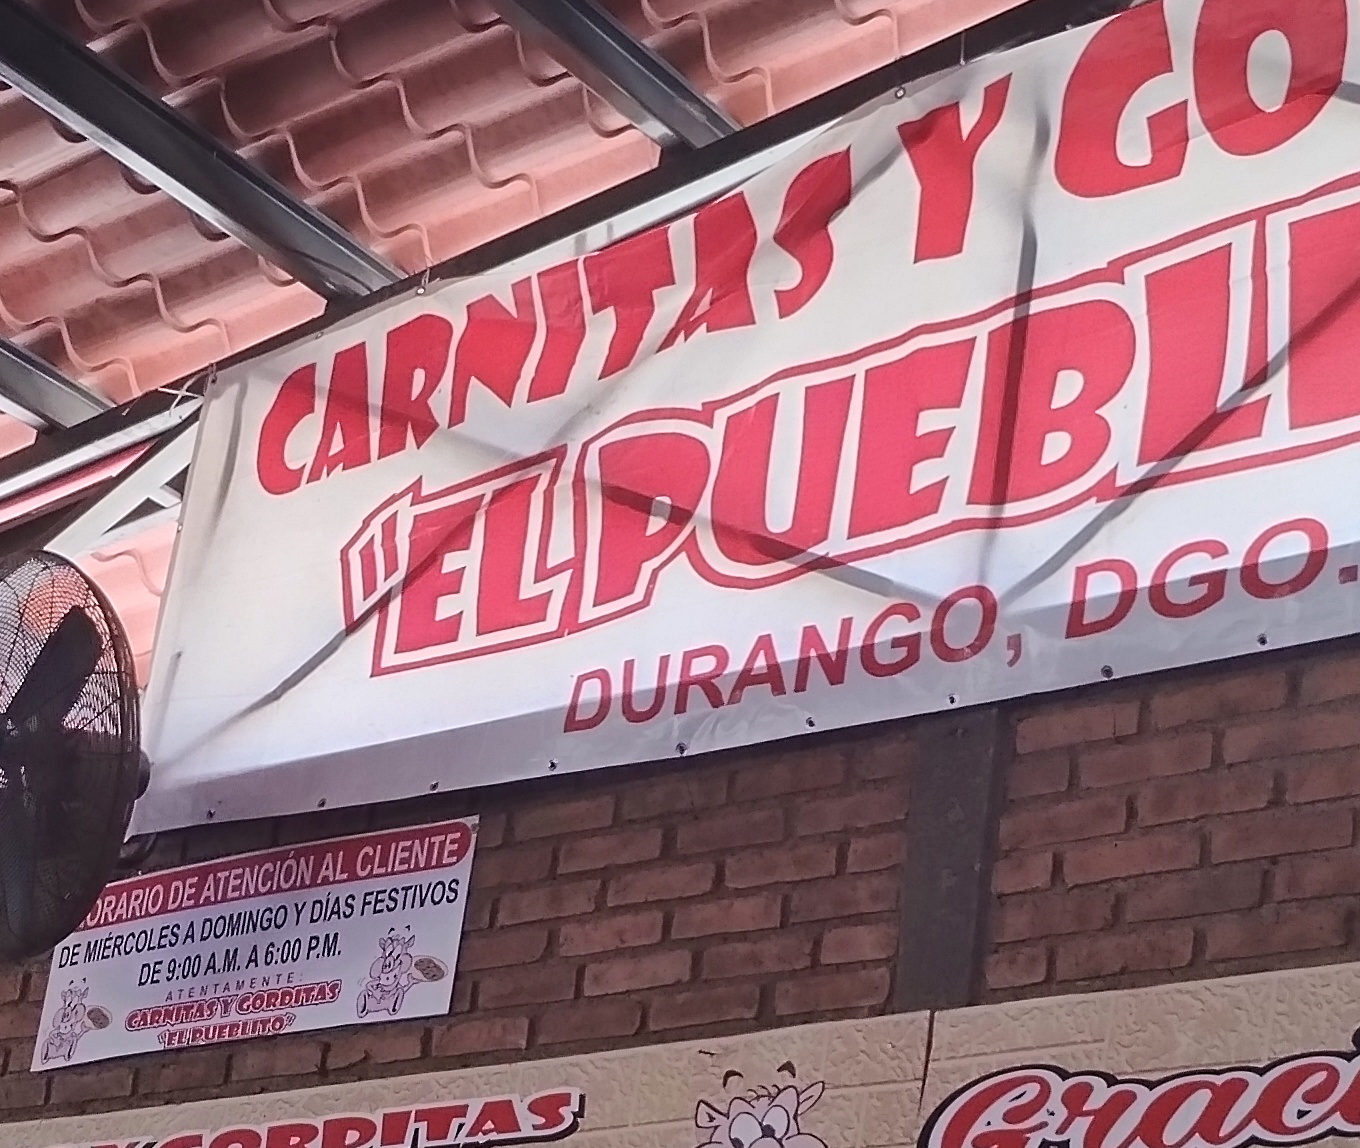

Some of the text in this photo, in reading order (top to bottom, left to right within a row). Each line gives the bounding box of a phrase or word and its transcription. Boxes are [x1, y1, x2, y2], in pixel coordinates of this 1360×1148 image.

[257, 146, 852, 497] CARNITAS
[896, 73, 1012, 262] Y
[342, 446, 577, 676] "EL
[564, 518, 1359, 732] DURANGO, DGO.
[58, 878, 460, 969] DE MIÉRCOLES A DOMINGO Y DÍAS FESTIVOS
[82, 832, 461, 929] ORARIO DE ATENCIÓN AL CLIENTE
[124, 979, 343, 1031] CARNITAS Y GORDITAS
[138, 931, 343, 987] DE 9:00 A.M. A 6:00 P.M.
[165, 971, 303, 1001] ATENTAMENTE:
